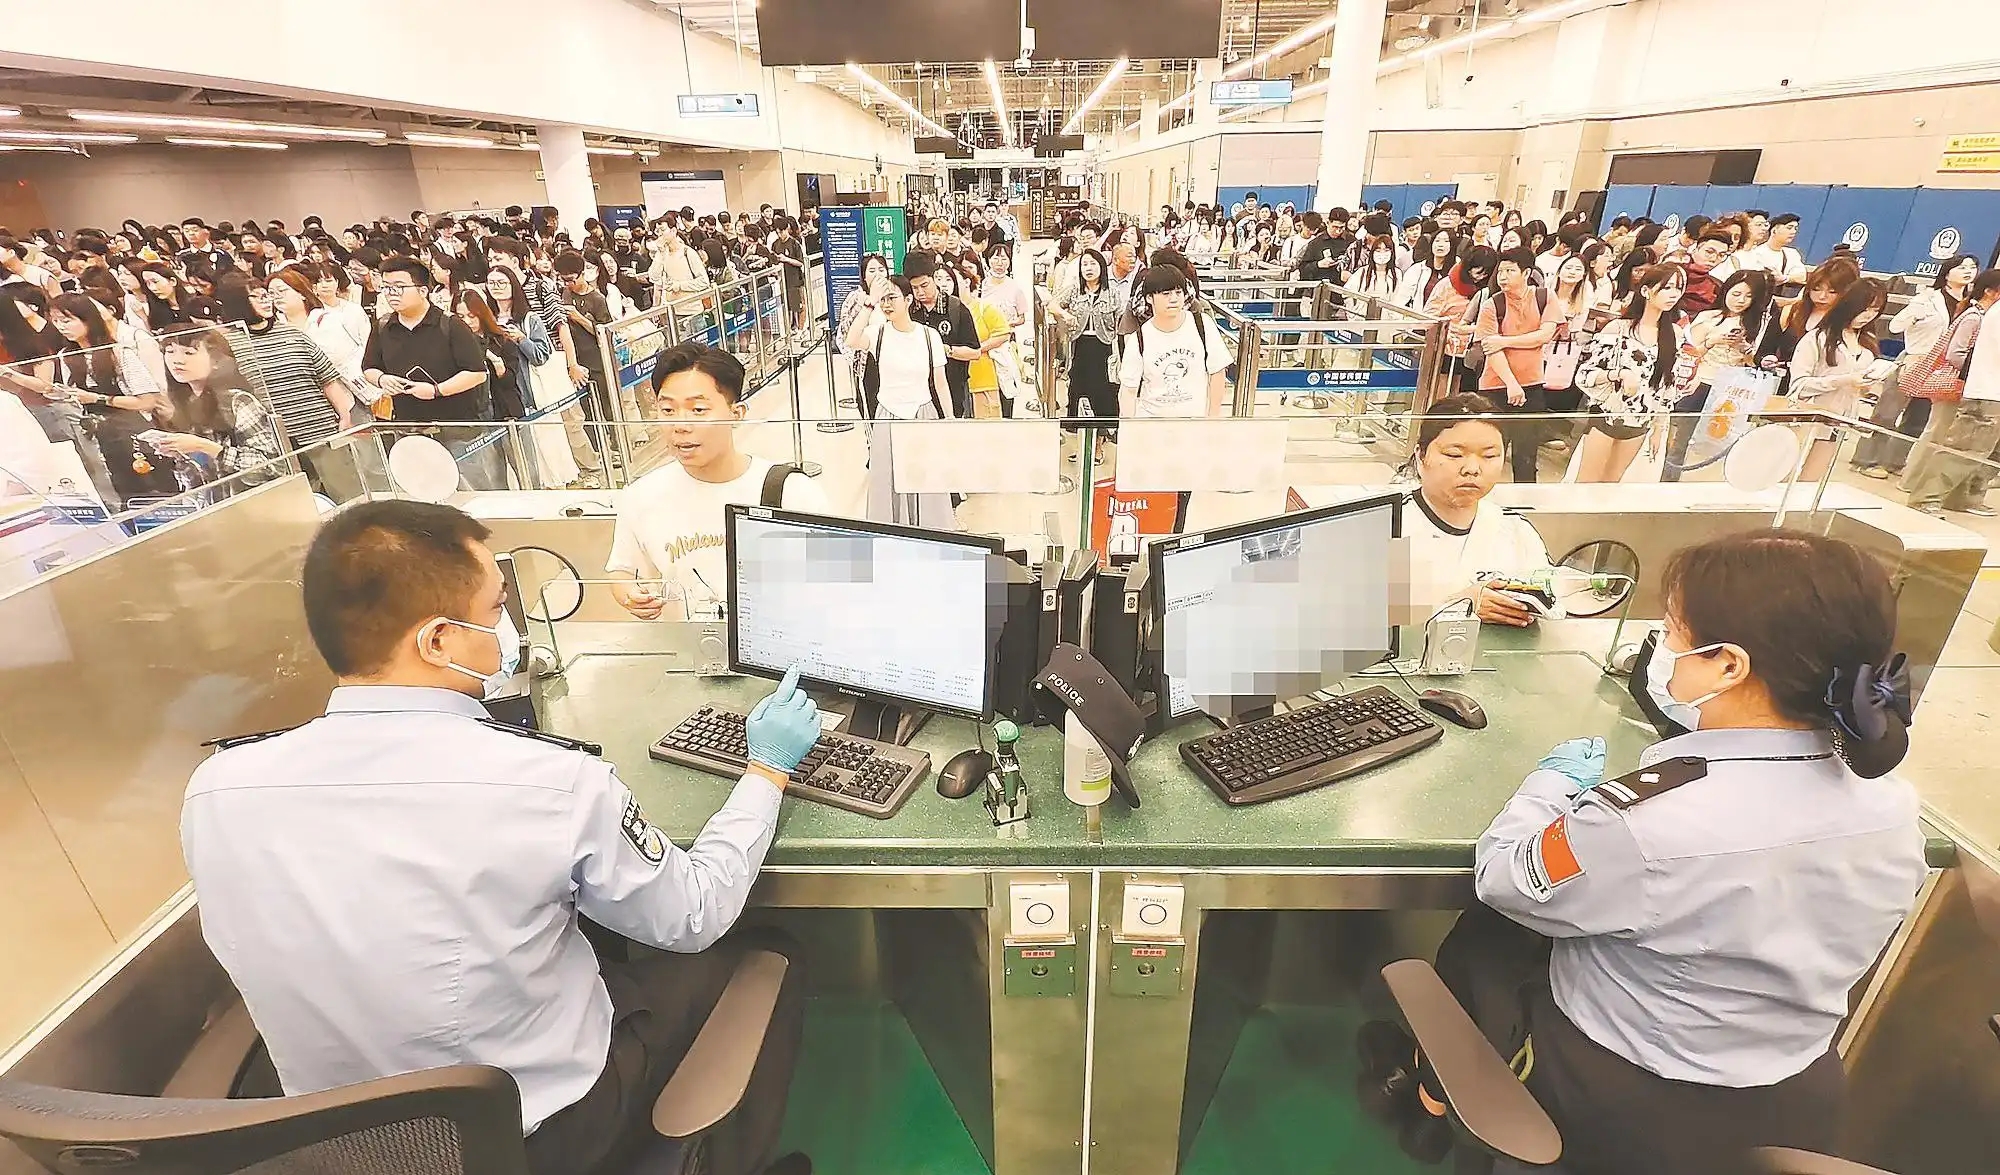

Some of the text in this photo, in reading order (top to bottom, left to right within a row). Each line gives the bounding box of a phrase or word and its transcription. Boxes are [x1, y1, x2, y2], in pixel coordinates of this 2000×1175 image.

[1915, 261, 1943, 276] POLI
[1153, 347, 1196, 367] PEANUTS
[1047, 672, 1086, 707] POLICE
